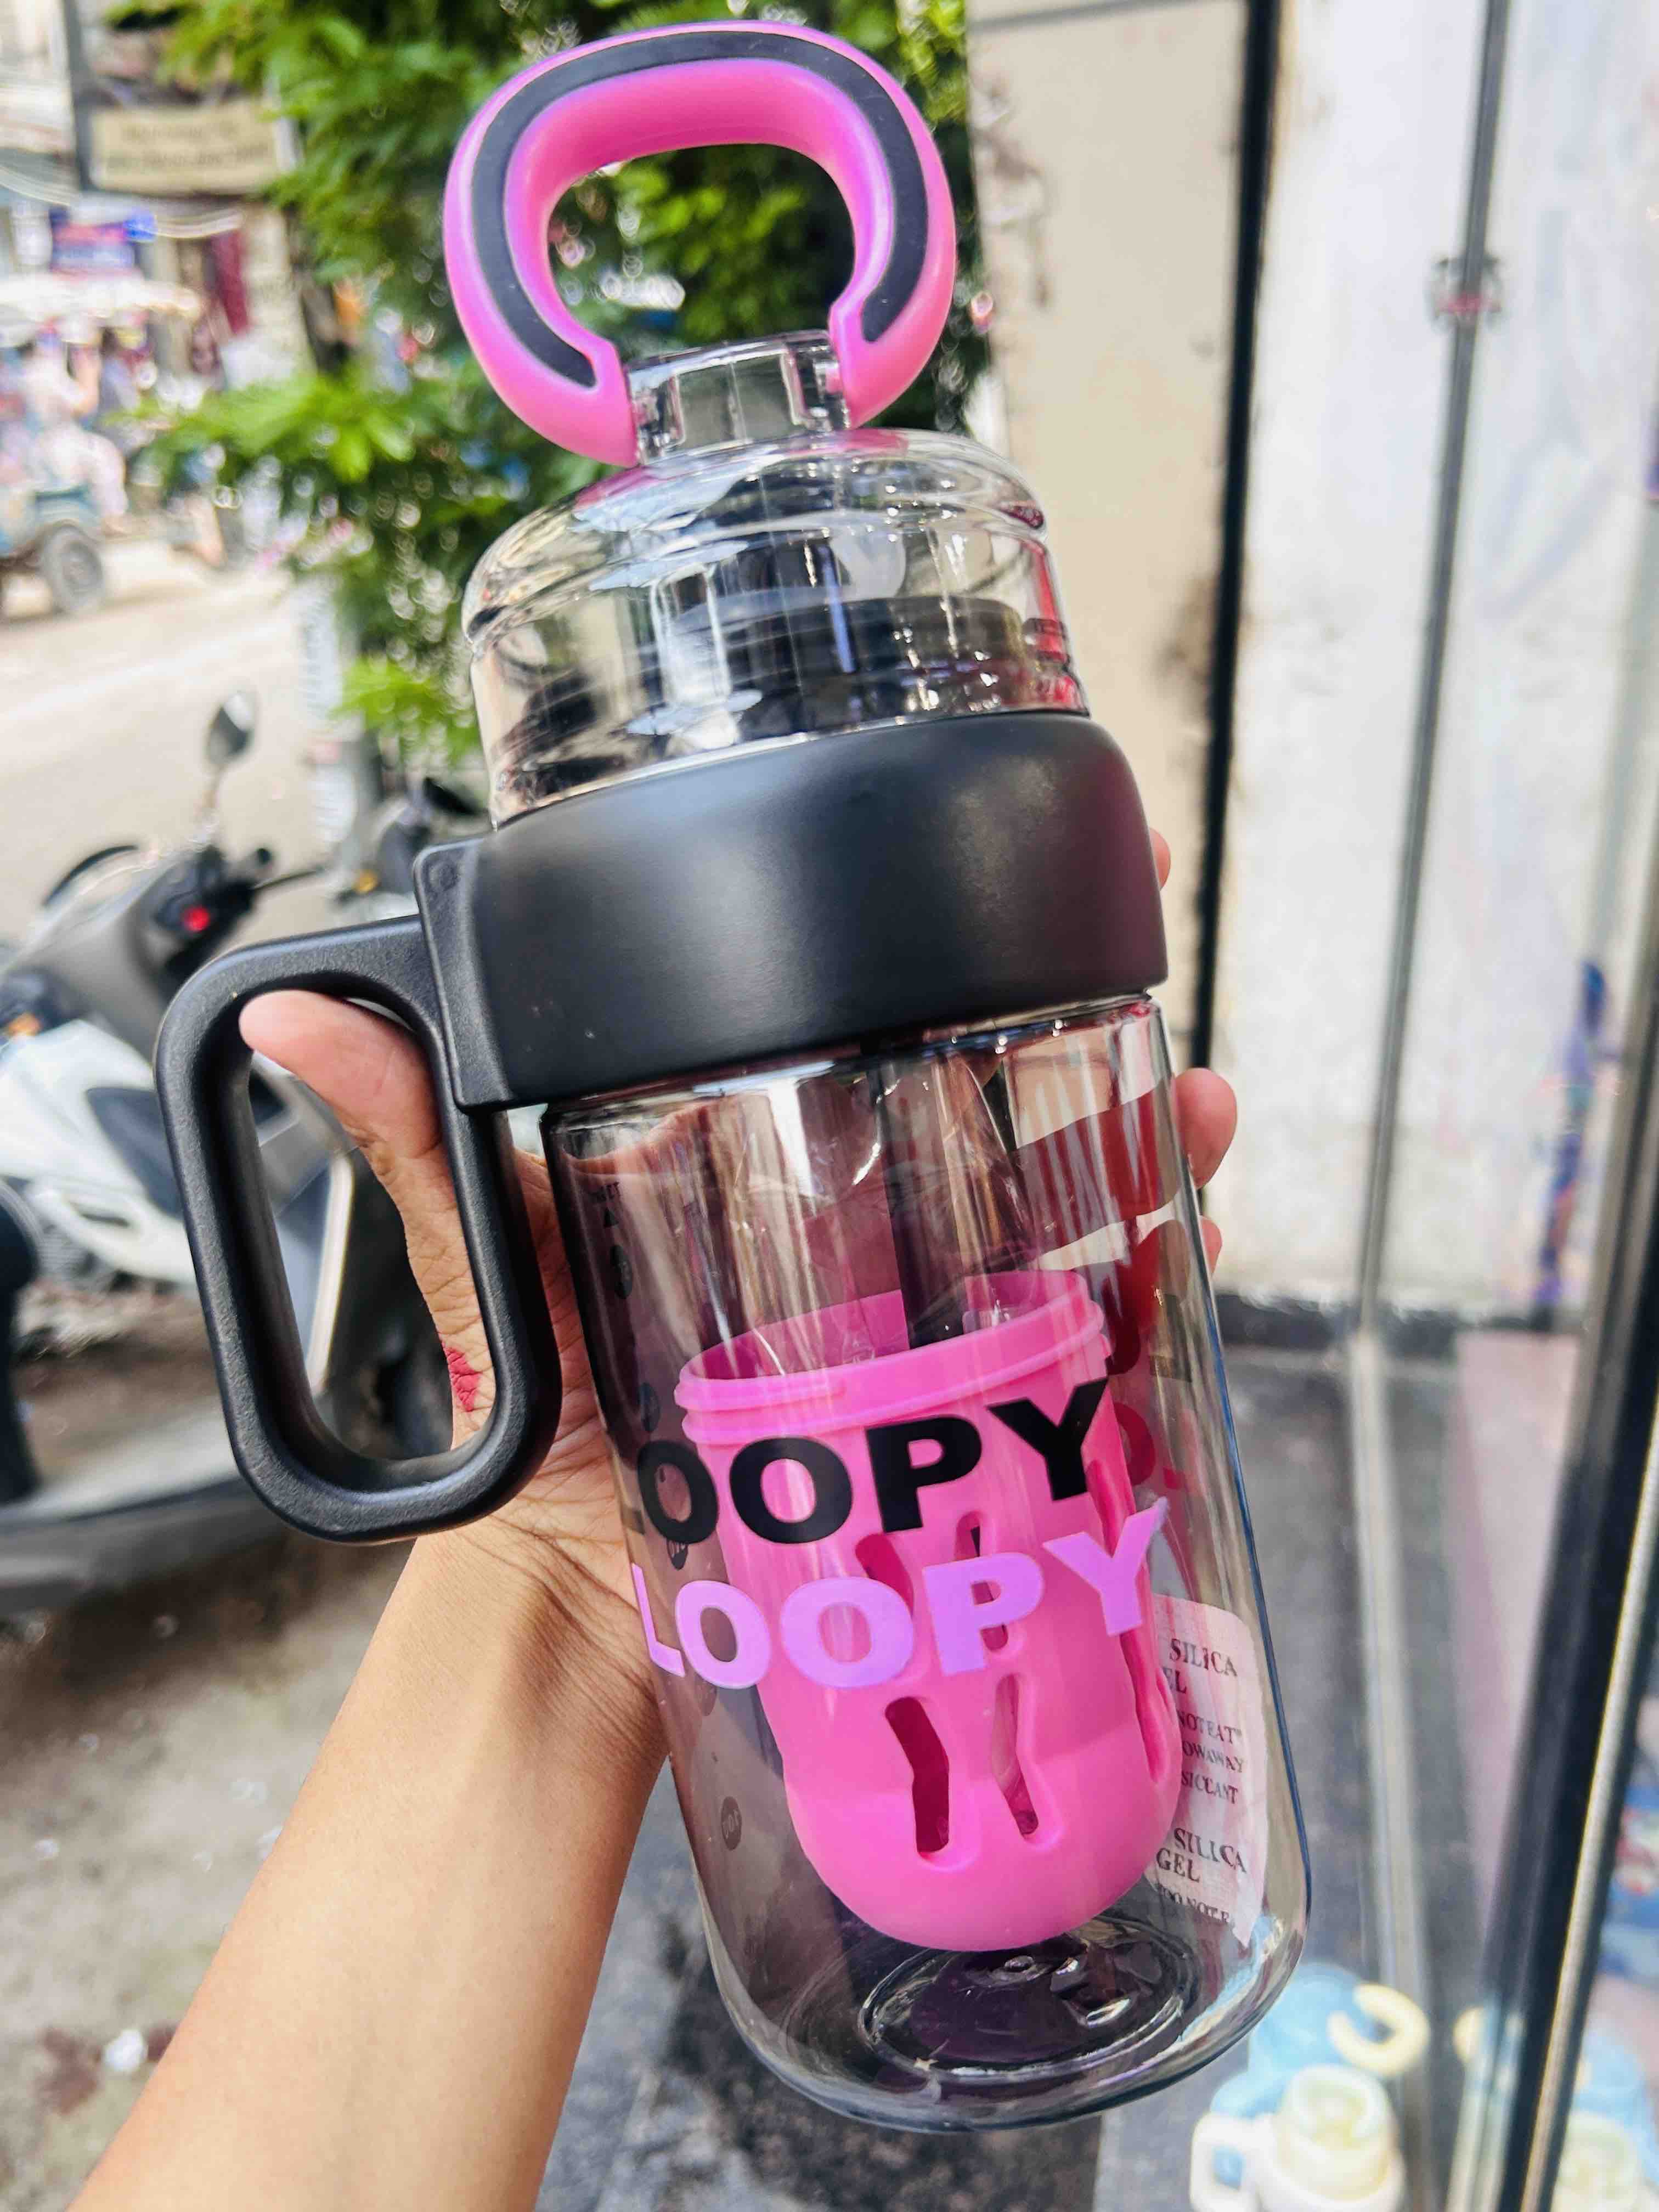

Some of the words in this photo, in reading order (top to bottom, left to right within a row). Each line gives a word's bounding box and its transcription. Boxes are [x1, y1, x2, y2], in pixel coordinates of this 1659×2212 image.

[631, 1497, 1168, 1689] LOOPY
[1169, 1638, 1238, 1677] SILICA
[1156, 1847, 1200, 1883] GEL
[1173, 1827, 1247, 1873] SILICA
